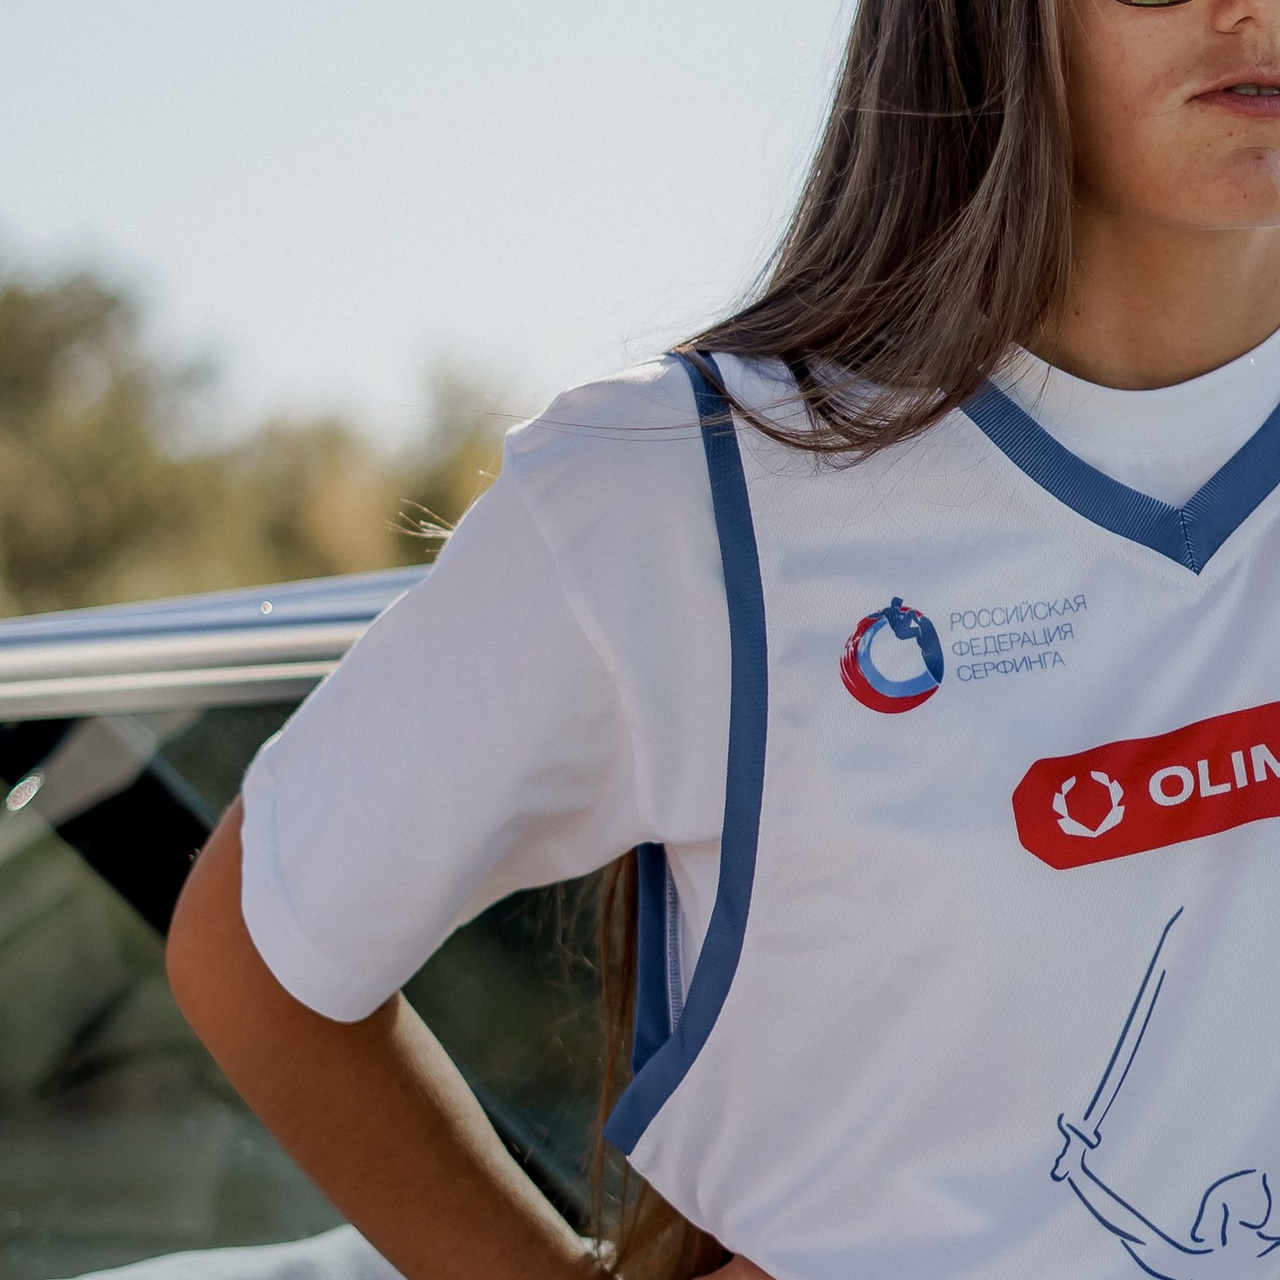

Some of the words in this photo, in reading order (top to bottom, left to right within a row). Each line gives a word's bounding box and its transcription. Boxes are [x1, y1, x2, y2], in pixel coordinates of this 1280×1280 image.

[950, 594, 1088, 631] РОССИЙСКАЯ
[951, 623, 1075, 657] ФЕДЕРАЦИЯ
[956, 651, 1066, 682] СЕРФИНГА
